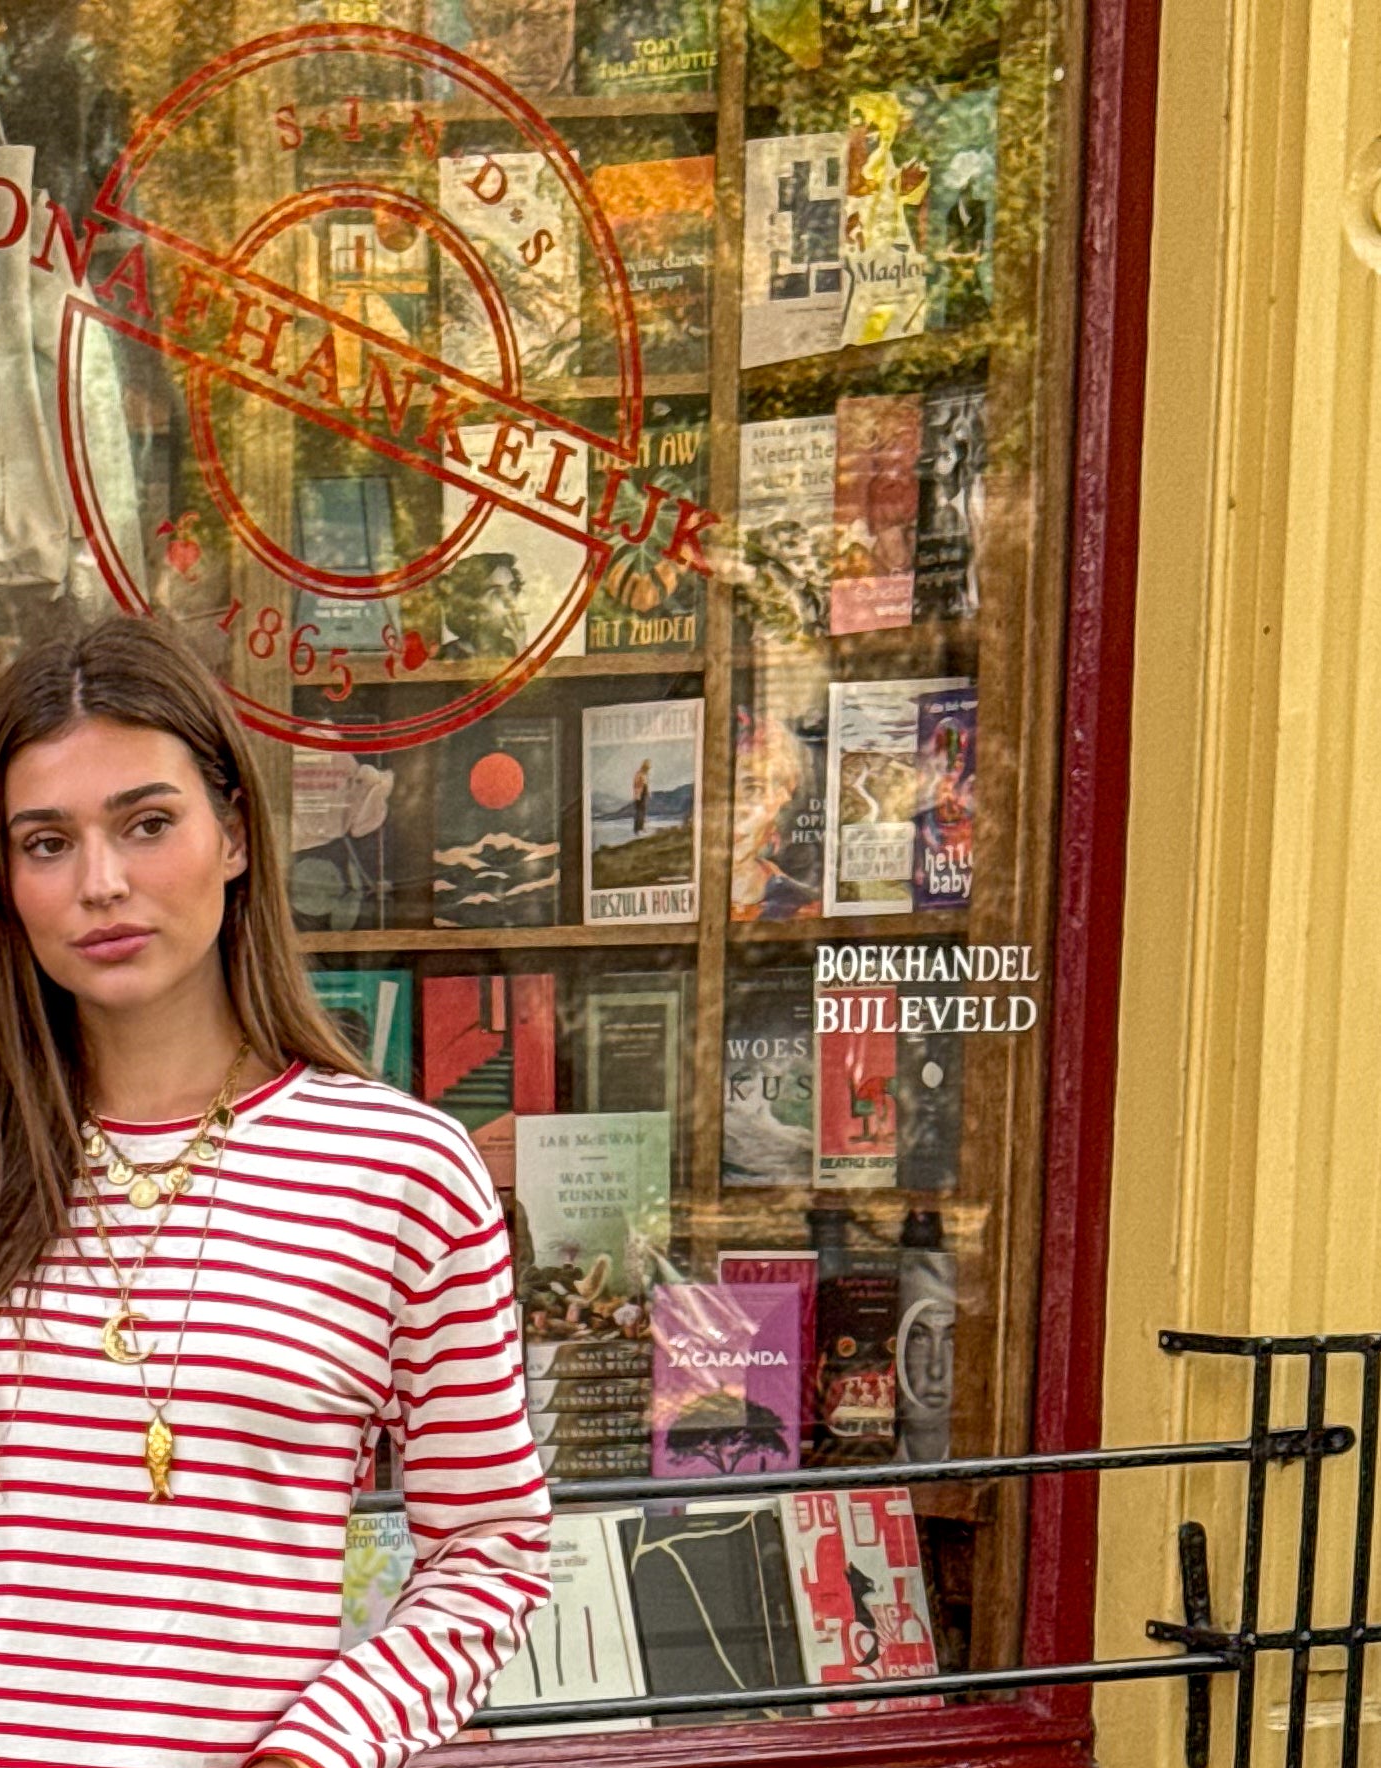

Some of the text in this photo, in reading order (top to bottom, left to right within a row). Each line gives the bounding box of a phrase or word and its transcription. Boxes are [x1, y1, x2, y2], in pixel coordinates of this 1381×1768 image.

[218, 599, 353, 700] 1865
[816, 944, 1039, 983] BOEKHANDEL
[814, 996, 1038, 1034] BIJLEVELD
[668, 1350, 788, 1368] JACARANDA
